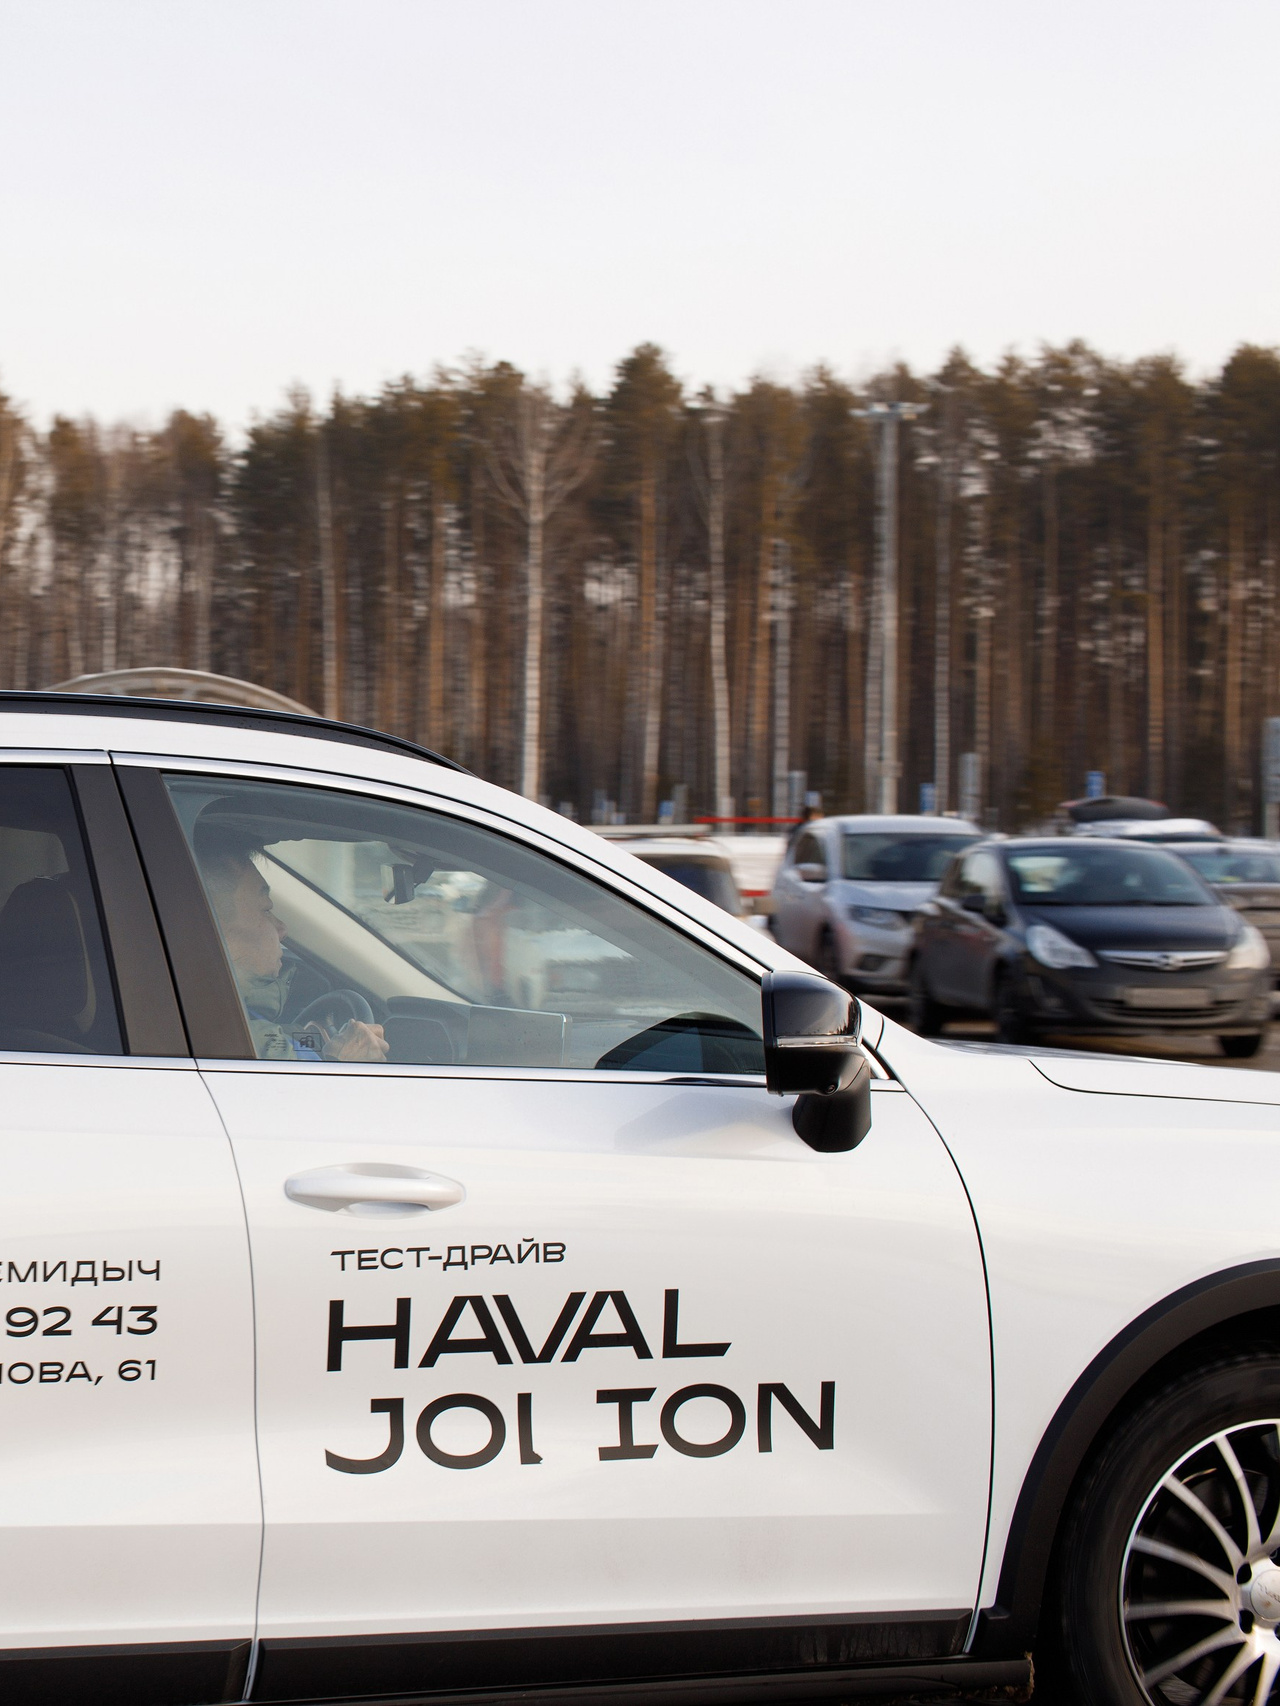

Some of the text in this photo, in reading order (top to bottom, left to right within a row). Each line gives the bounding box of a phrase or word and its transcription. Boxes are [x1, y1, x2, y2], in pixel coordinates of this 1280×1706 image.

[329, 1237, 568, 1272] ТЕСТ-ДРАЙВ
[5, 1306, 73, 1338] 92
[90, 1305, 159, 1336] 43
[326, 1288, 732, 1372] HAVAL
[117, 1359, 157, 1382] 61
